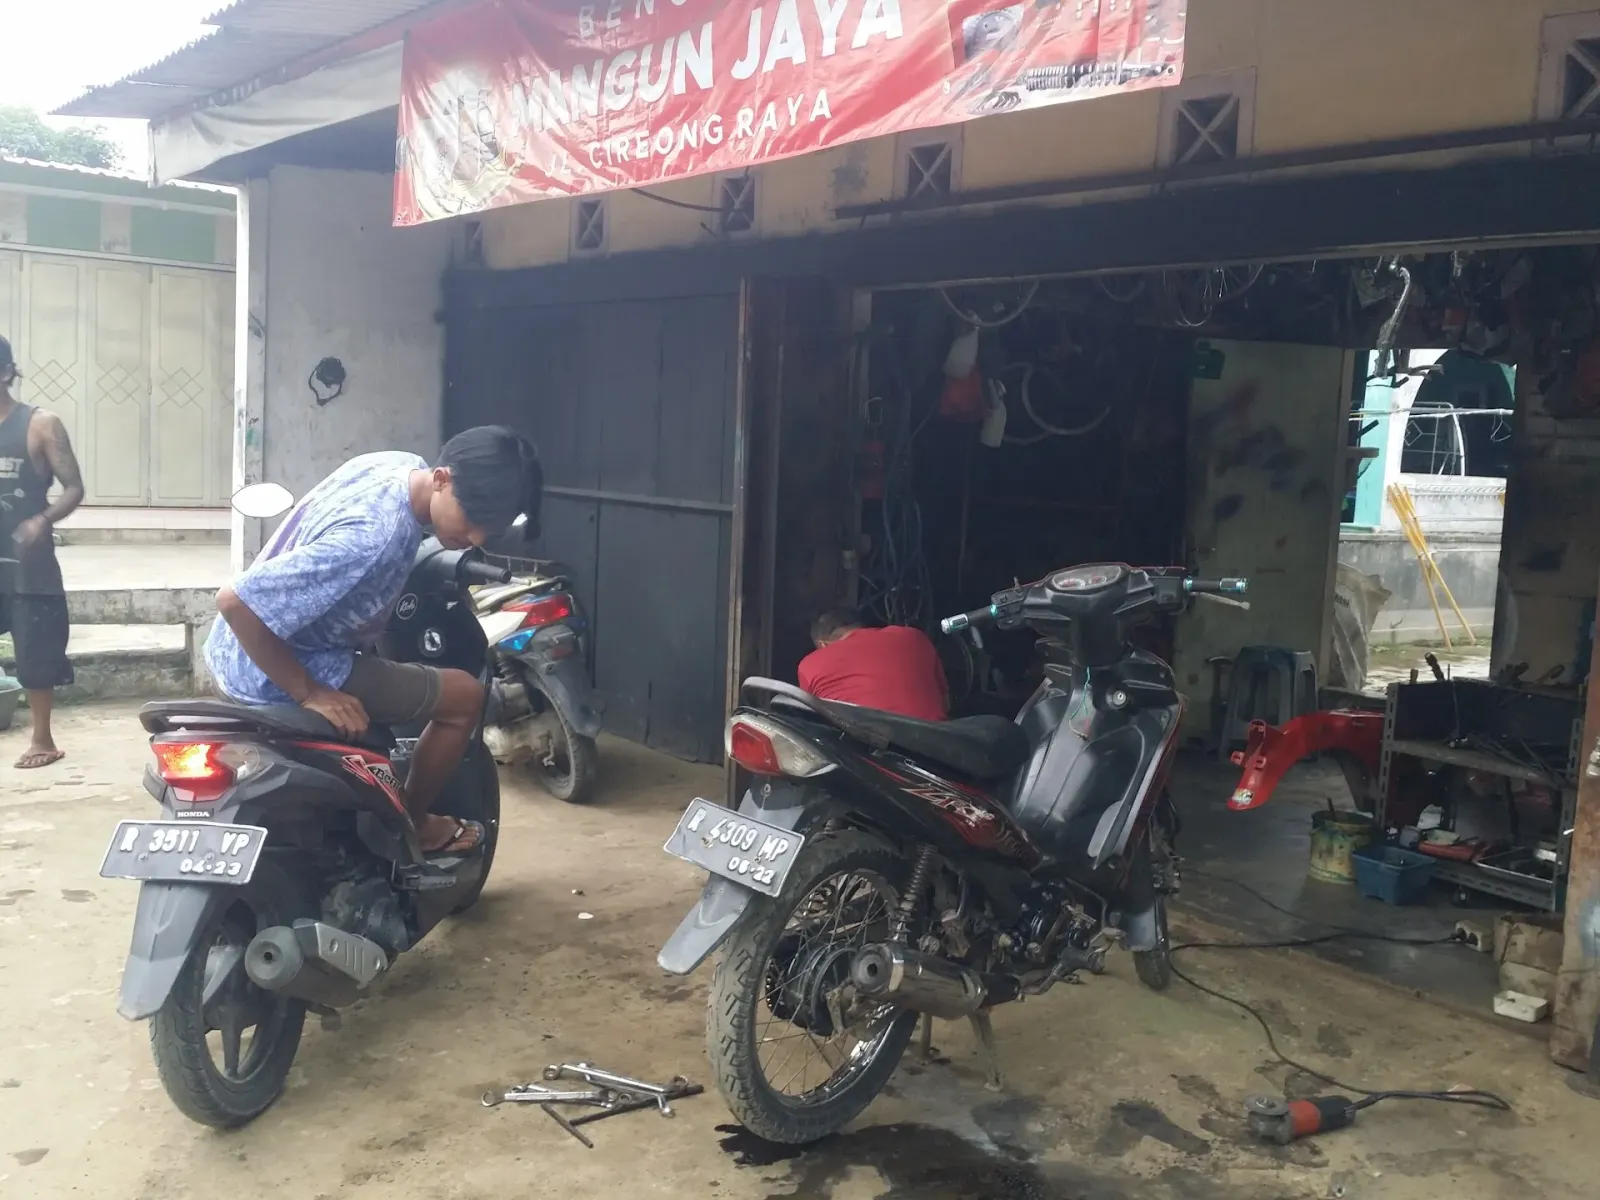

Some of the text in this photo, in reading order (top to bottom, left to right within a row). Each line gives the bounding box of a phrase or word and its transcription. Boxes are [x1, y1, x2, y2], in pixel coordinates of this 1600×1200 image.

[731, 0, 903, 80] JAYA
[588, 114, 723, 169] CIREONG
[737, 89, 832, 139] RAYA
[177, 810, 211, 818] HONDA
[687, 808, 789, 862] R 4309 MP
[120, 827, 249, 856] R 3511 VP
